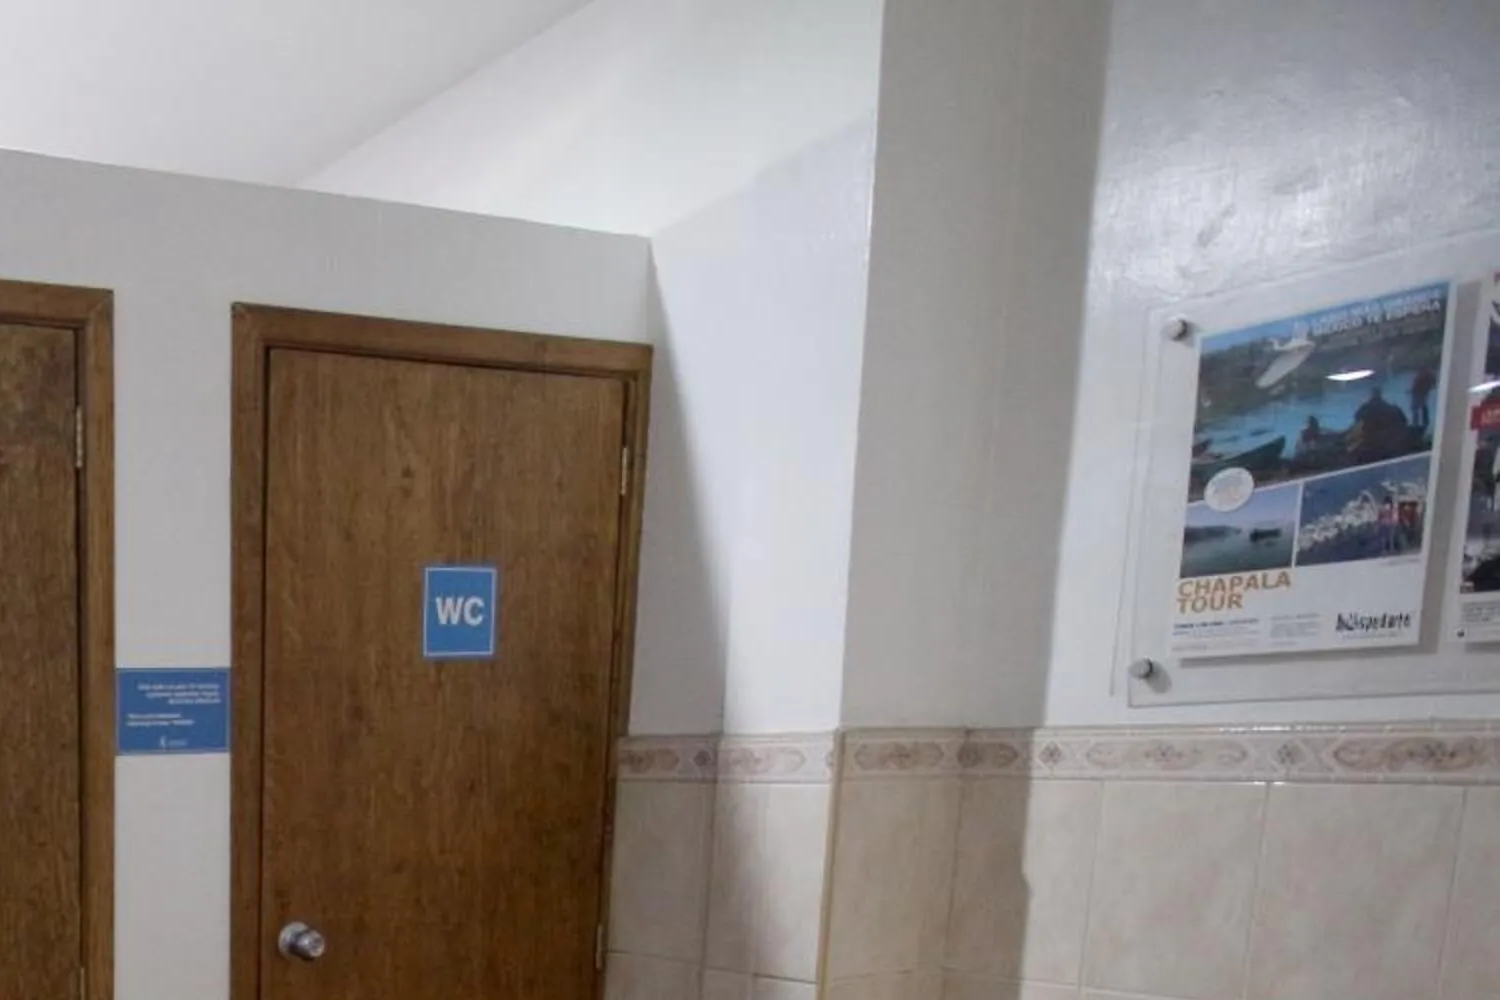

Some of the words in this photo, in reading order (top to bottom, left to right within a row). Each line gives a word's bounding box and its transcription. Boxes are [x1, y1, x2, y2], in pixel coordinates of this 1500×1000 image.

[1177, 571, 1292, 598] CHAPALA
[435, 596, 484, 627] WC
[1176, 593, 1243, 615] TOUR
